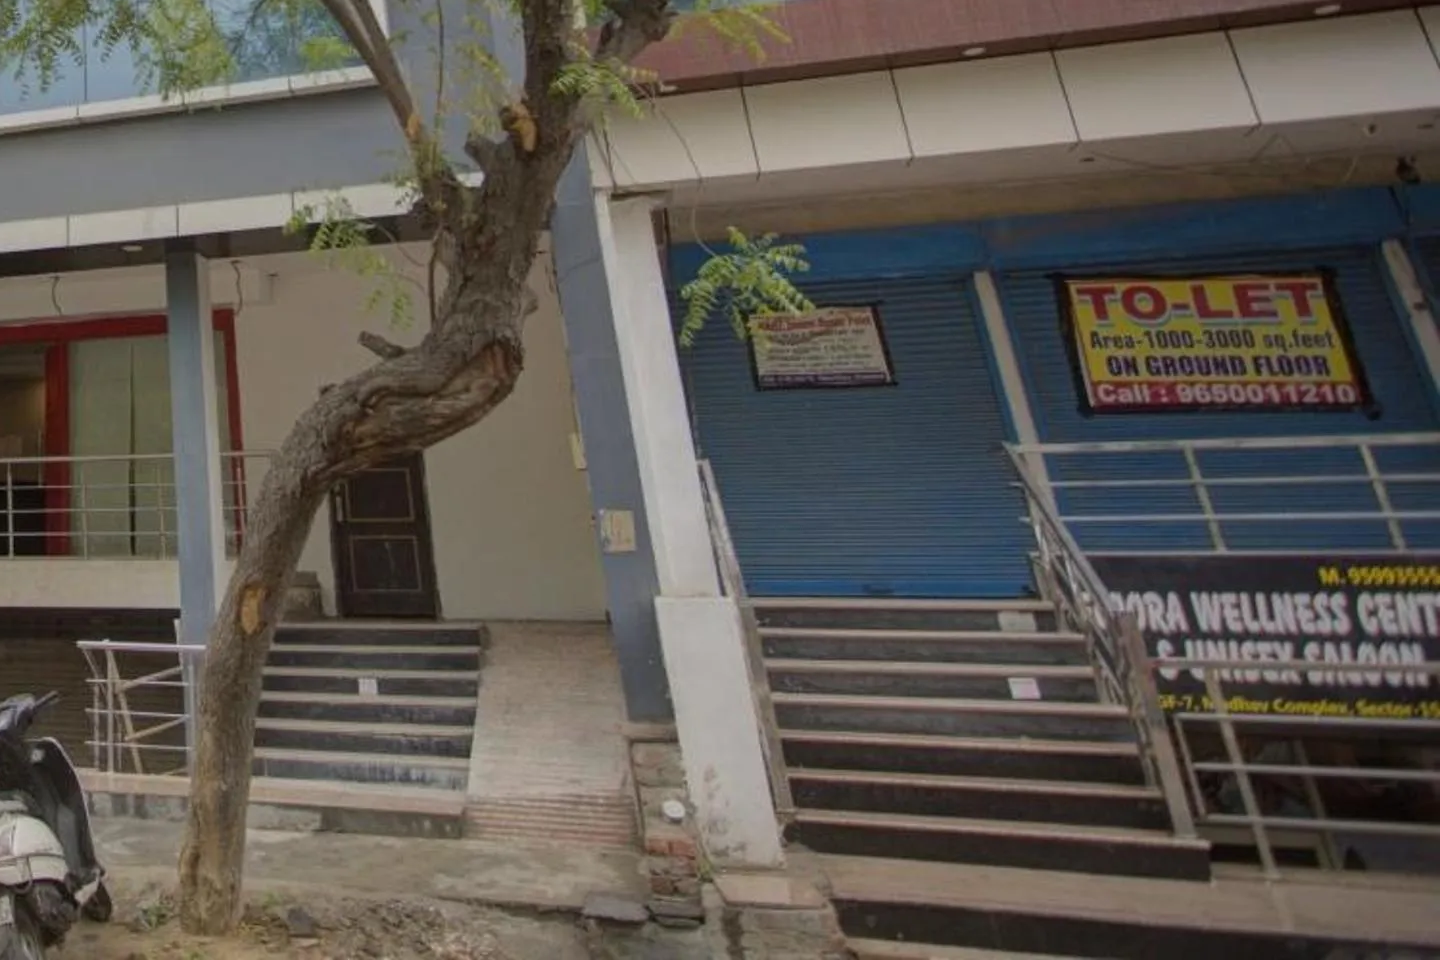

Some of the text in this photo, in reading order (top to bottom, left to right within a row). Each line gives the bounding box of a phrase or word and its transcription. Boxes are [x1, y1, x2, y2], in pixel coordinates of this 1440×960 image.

[1075, 282, 1321, 327] TO-LET
[1106, 352, 1331, 378] ON GROUND FLOOR
[1095, 384, 1150, 405] Call
[1190, 590, 1353, 636] WELLNESS
[1357, 591, 1440, 638] CENT
[1303, 641, 1429, 688] SALOON
